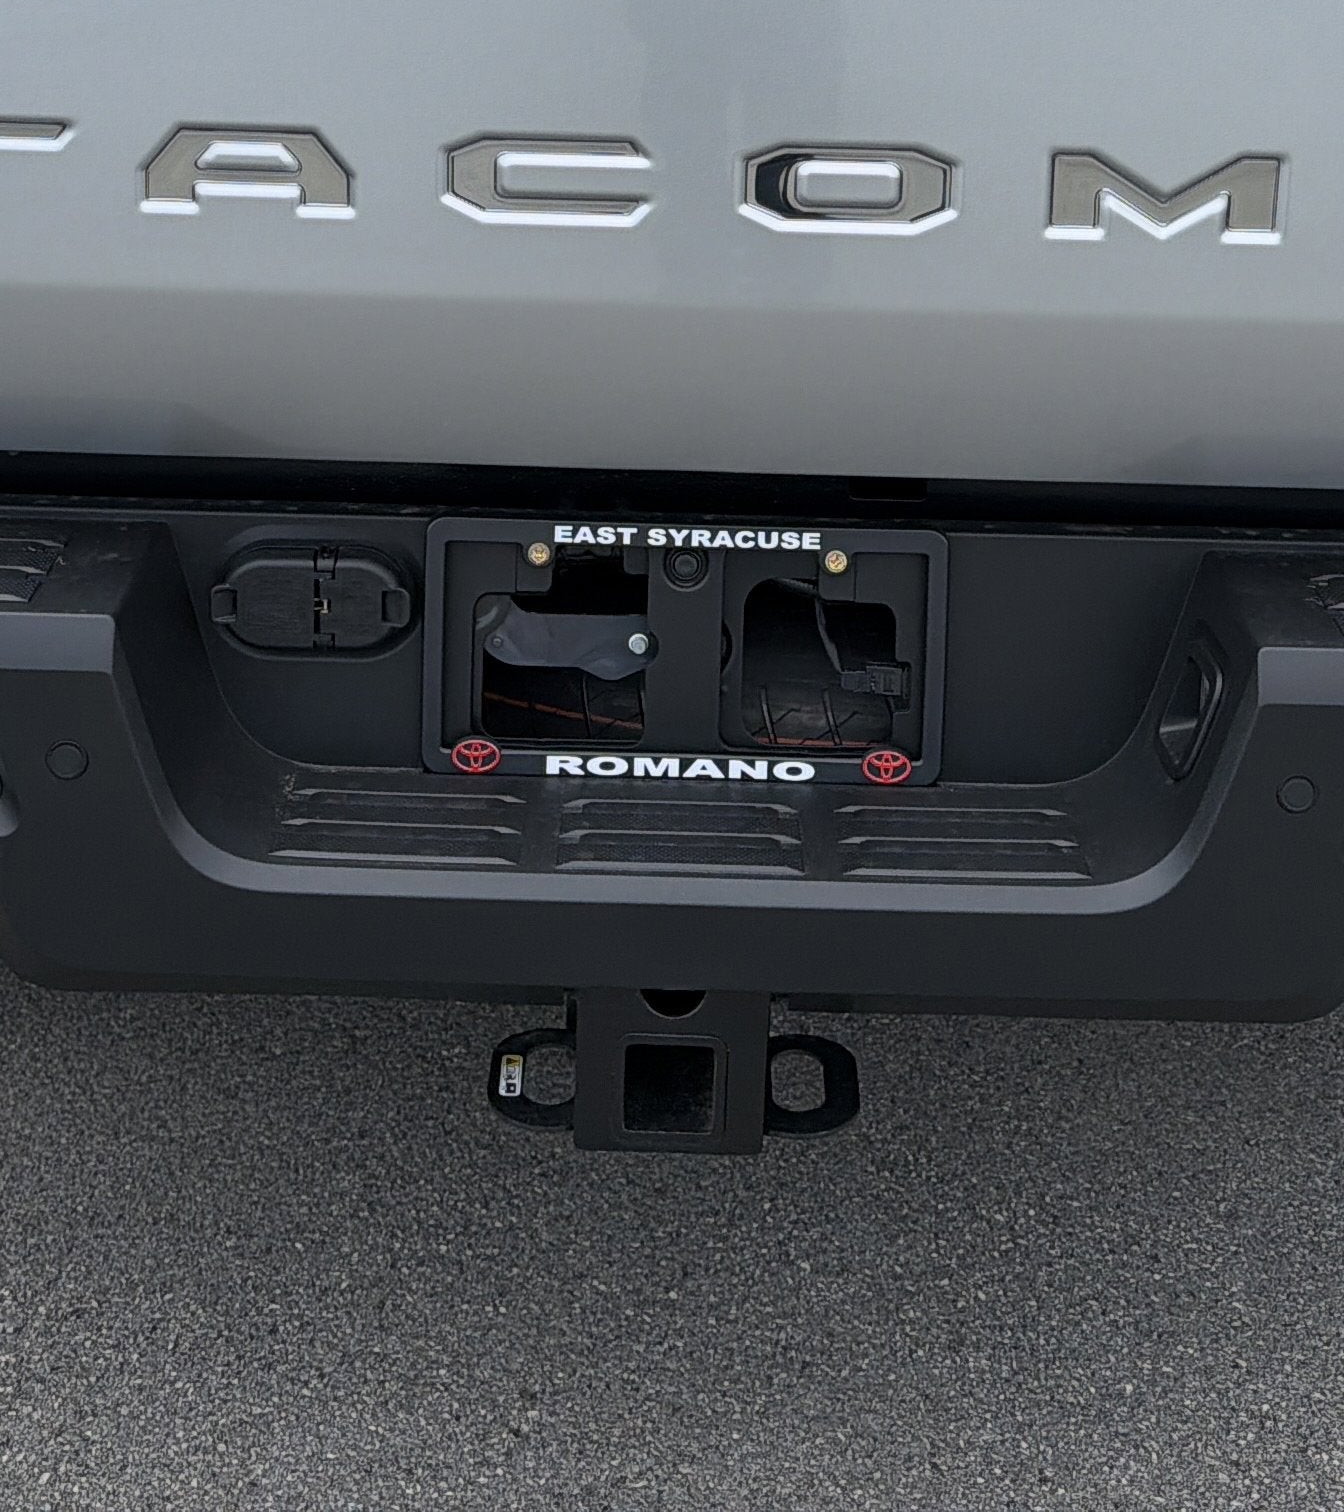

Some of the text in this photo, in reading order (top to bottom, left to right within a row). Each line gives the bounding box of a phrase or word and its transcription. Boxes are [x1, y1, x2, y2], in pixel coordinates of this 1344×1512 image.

[554, 525, 821, 550] EAST SYRACUSE
[545, 755, 816, 782] ROMANO
